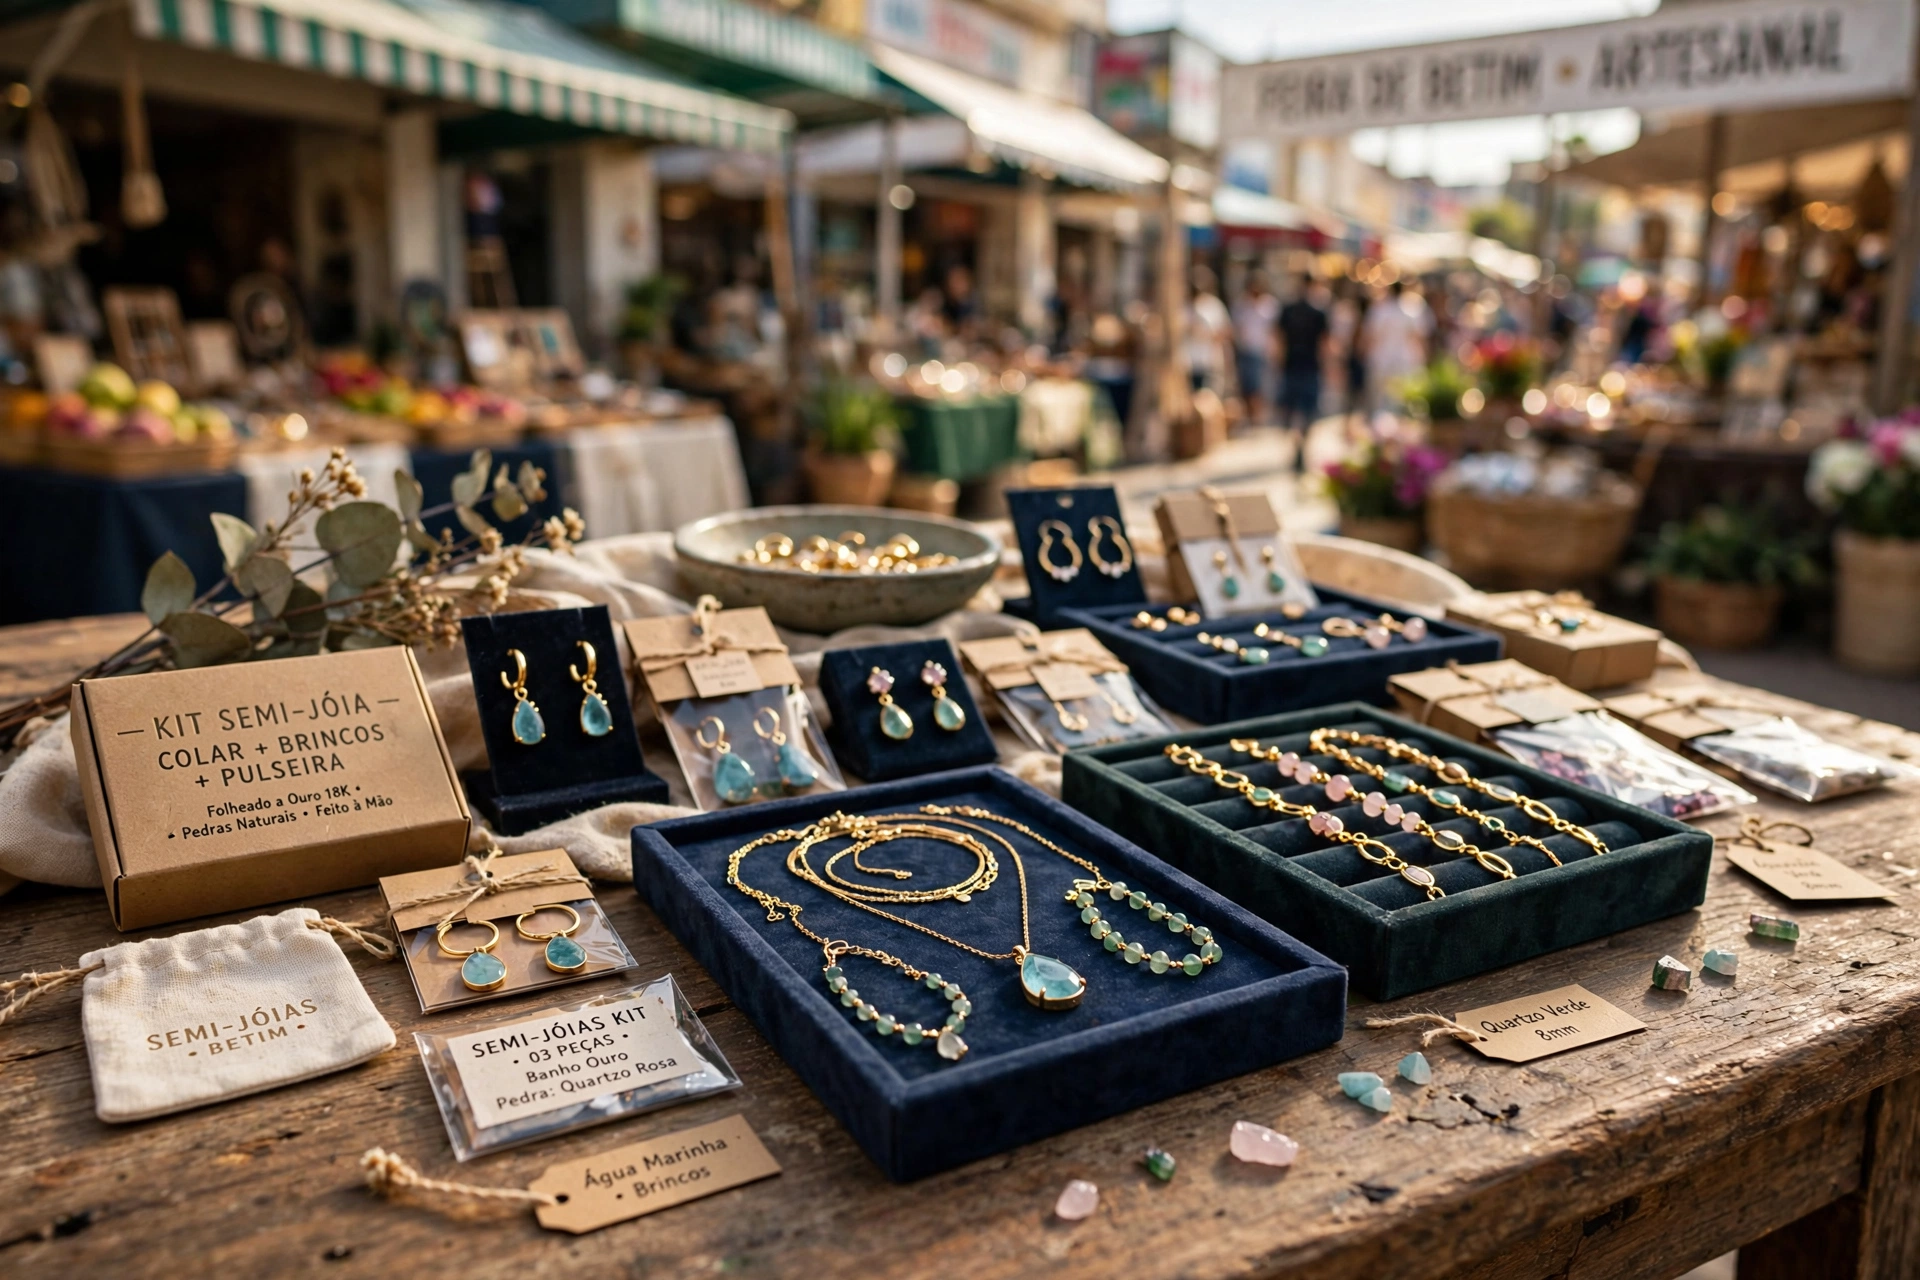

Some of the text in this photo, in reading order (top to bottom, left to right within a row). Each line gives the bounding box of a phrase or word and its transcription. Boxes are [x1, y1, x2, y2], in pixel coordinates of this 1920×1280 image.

[1589, 9, 1847, 92] ARTESANAL
[153, 691, 371, 740] KIT SEMI-JÓIA
[158, 723, 385, 771] COLAR + BRINCOS
[195, 752, 345, 788] + PULSEIRA
[182, 795, 393, 839] Pedras Naturais Feito à Mão
[207, 784, 352, 818] Folheado a Ouro 18K
[146, 999, 318, 1051] SEMI-JÓIAS
[472, 1006, 647, 1058] SEMI-JÓIAS KIT
[1480, 999, 1591, 1034] Quartzo Verde
[1535, 1024, 1580, 1041] 8mm
[209, 1025, 288, 1056] BETIM
[529, 1034, 615, 1064] 03 PEÇAS
[496, 1056, 678, 1109] Pedra: Quartzo Rosa
[525, 1053, 629, 1083] Banho Ouro
[584, 1136, 728, 1190] Água Marinha
[633, 1164, 711, 1198] Brincos
